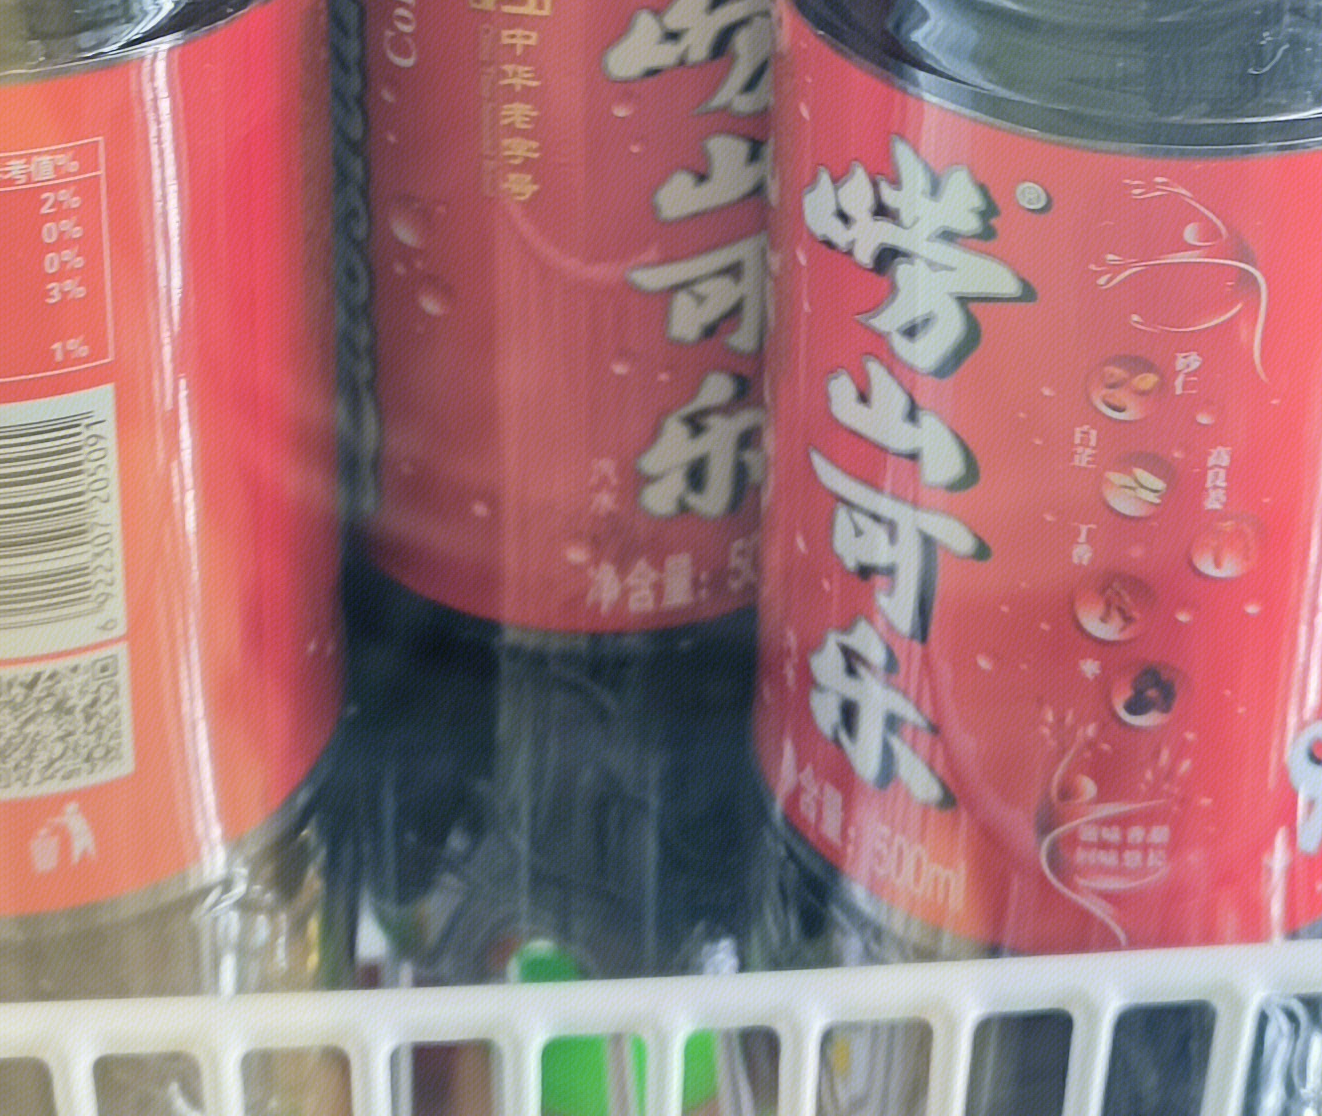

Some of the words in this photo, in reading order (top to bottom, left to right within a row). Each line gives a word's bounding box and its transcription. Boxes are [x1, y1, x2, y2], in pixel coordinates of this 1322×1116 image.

[499, 28, 543, 201] 中华老字号
[38, 189, 82, 215] 2%
[41, 218, 84, 245] 0%
[43, 248, 85, 275] 0%
[45, 278, 87, 305] 3%
[49, 336, 90, 364] 1%
